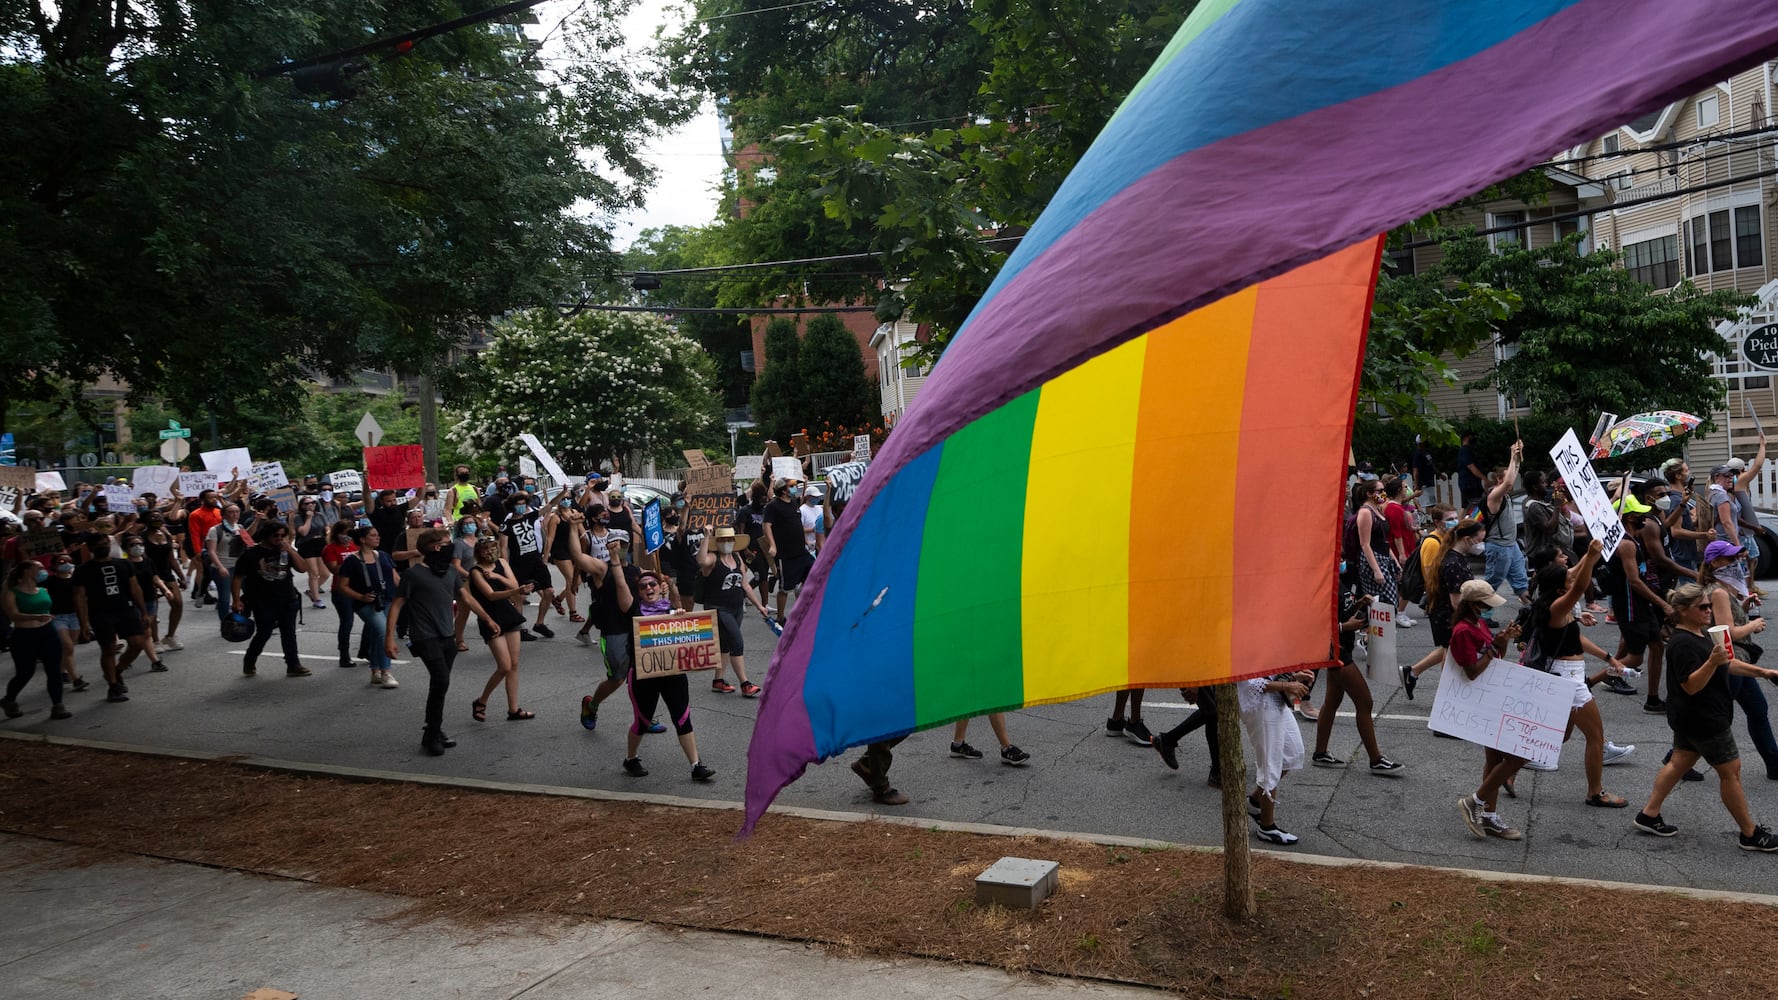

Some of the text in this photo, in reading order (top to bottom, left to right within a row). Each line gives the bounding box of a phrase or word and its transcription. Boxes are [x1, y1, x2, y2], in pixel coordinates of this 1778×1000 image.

[1760, 351, 1778, 364] Ar
[375, 448, 419, 464] BLACK
[1555, 444, 1580, 474] THIS
[1570, 461, 1598, 498] IS NOT
[833, 485, 855, 502] MAT
[690, 496, 736, 510] ABOLISH
[512, 518, 533, 535] EK
[688, 514, 731, 529] POLICE
[1370, 608, 1391, 622] TICE
[650, 618, 700, 636] NO PRIDE
[652, 634, 700, 646] THIS MONTH
[642, 644, 717, 674] ONLY RAGE
[1446, 679, 1492, 704] NOT
[1520, 674, 1560, 697] ARE
[1501, 695, 1549, 723] BORN
[1440, 702, 1494, 736] RACIST.
[1505, 718, 1538, 736] STOP
[1518, 734, 1560, 753] TEACHING
